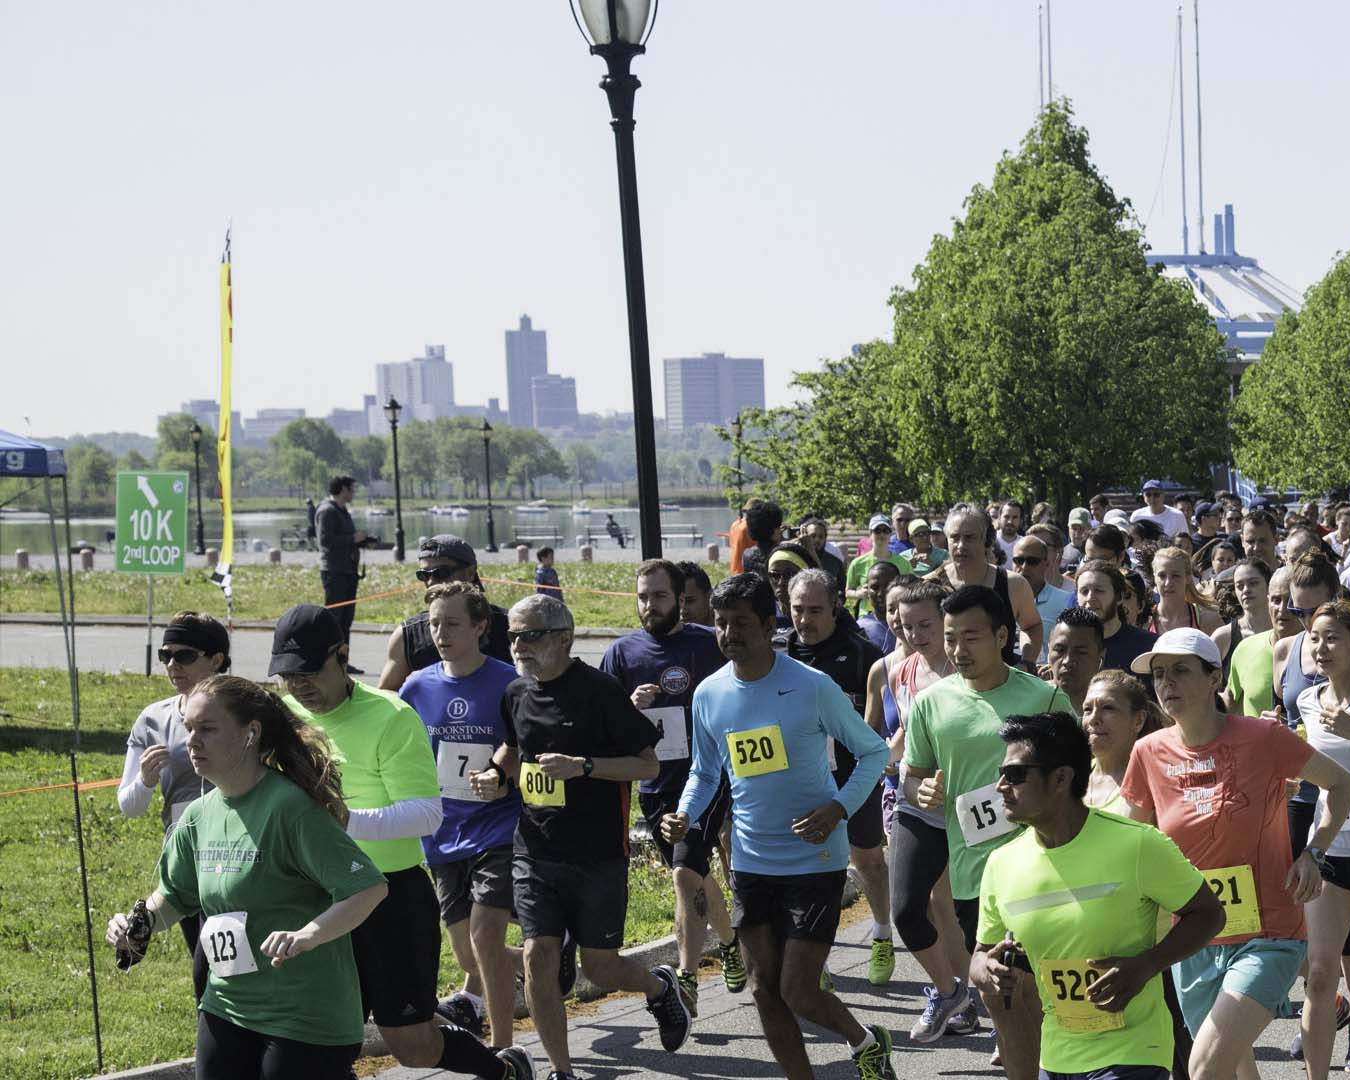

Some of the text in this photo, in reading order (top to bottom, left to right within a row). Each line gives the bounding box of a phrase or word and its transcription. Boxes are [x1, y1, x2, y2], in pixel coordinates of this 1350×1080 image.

[130, 509, 174, 542] 10 K
[142, 545, 181, 566] LOOP
[427, 725, 494, 736] BROOKSTONE
[735, 736, 775, 765] 520
[457, 755, 469, 778] 7
[970, 799, 997, 830] 15
[1210, 876, 1242, 905] 21
[209, 930, 238, 963] 123
